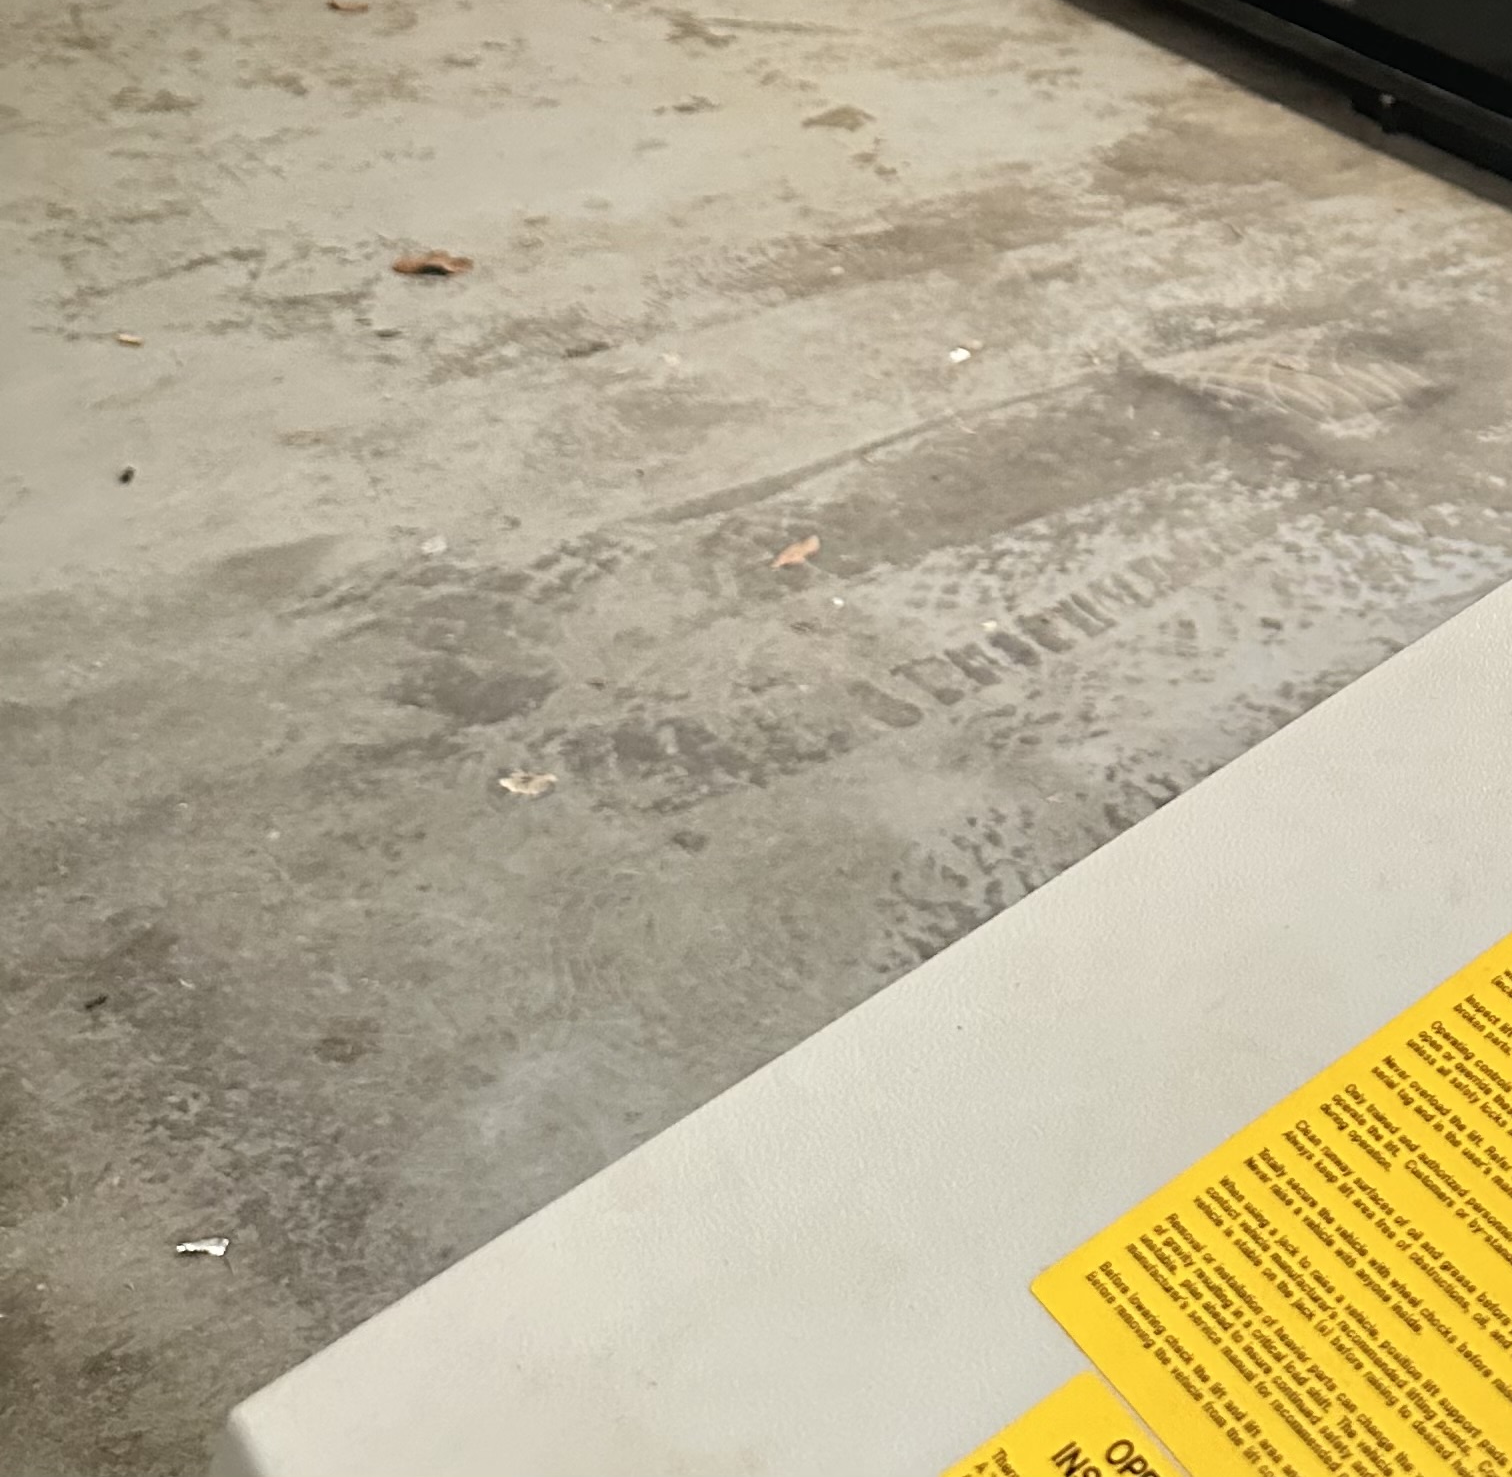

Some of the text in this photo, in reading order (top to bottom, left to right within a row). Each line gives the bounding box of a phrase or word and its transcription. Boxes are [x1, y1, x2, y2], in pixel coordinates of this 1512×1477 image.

[1418, 1030, 1443, 1052] open
[1441, 1051, 1455, 1061] or
[1452, 1002, 1485, 1032] broken
[1464, 994, 1500, 1025] Inspect
[1405, 1039, 1436, 1065] unless
[1435, 1065, 1452, 1076] all
[1449, 1077, 1480, 1103] safety
[1479, 1101, 1507, 1127] locks
[1430, 1020, 1475, 1061] Operating
[1473, 1059, 1512, 1093] controls
[1344, 1083, 1366, 1105] Only
[1365, 1103, 1400, 1134] trained
[1397, 1134, 1420, 1152] and
[1416, 1152, 1469, 1197] authorized
[1381, 1055, 1410, 1080] Never
[1409, 1081, 1451, 1116] overload
[1448, 1114, 1466, 1131] the
[1483, 1145, 1512, 1171] Refer
[1397, 1088, 1414, 1106] tag
[1413, 1105, 1436, 1122] and
[1432, 1121, 1444, 1132] in
[1444, 1130, 1461, 1147] the
[1331, 1094, 1366, 1126] operate
[1366, 1124, 1383, 1141] the
[1404, 1159, 1455, 1207] Customers
[1455, 1208, 1469, 1219] or
